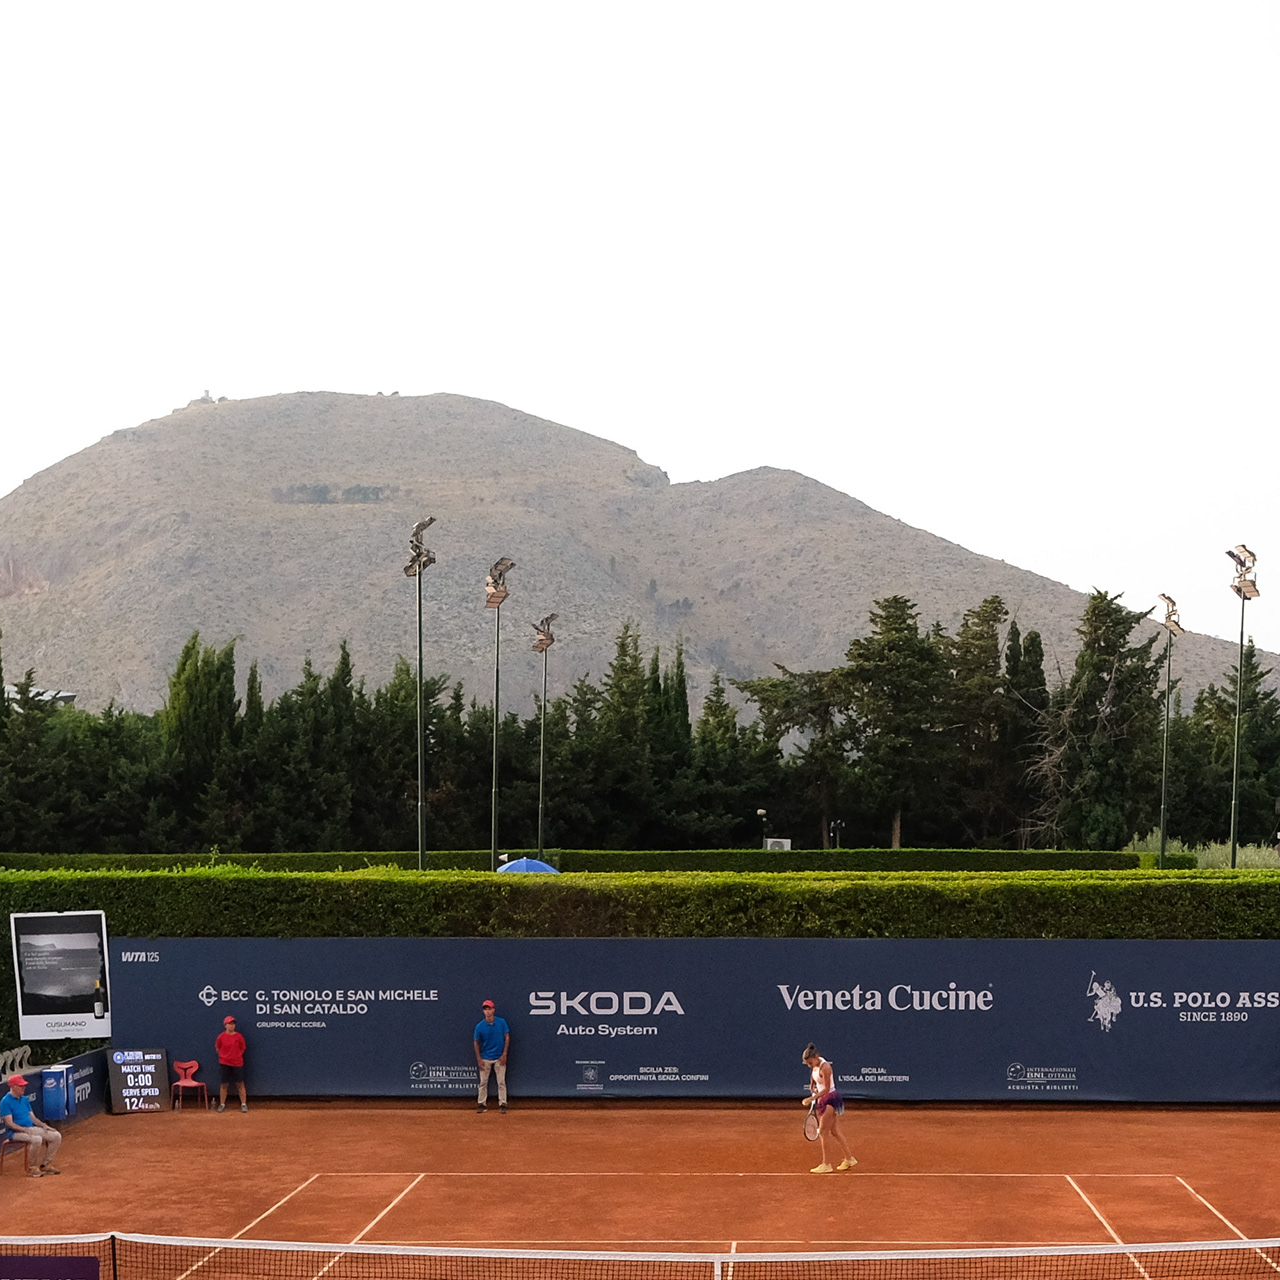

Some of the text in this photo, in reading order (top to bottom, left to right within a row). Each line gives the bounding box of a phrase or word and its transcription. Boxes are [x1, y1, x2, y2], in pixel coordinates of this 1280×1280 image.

[122, 951, 160, 962] WTA 125
[221, 990, 439, 1001] BCC G. TONIOLO E SAN MICHELE
[776, 981, 994, 1011] Veneta Cucine
[1129, 992, 1168, 1008] U.S.
[1173, 992, 1231, 1008] POLO
[256, 1003, 368, 1015] DI SAN CATALDO
[1179, 1012, 1248, 1022] SINCE 1890
[46, 1020, 87, 1028] CUSUMANO
[557, 1024, 658, 1038] Auto System
[121, 1064, 156, 1073] MATCH TIME
[127, 1074, 152, 1087] 0:00
[122, 1088, 160, 1097] SERVE SPEED
[124, 1097, 144, 1110] 124
